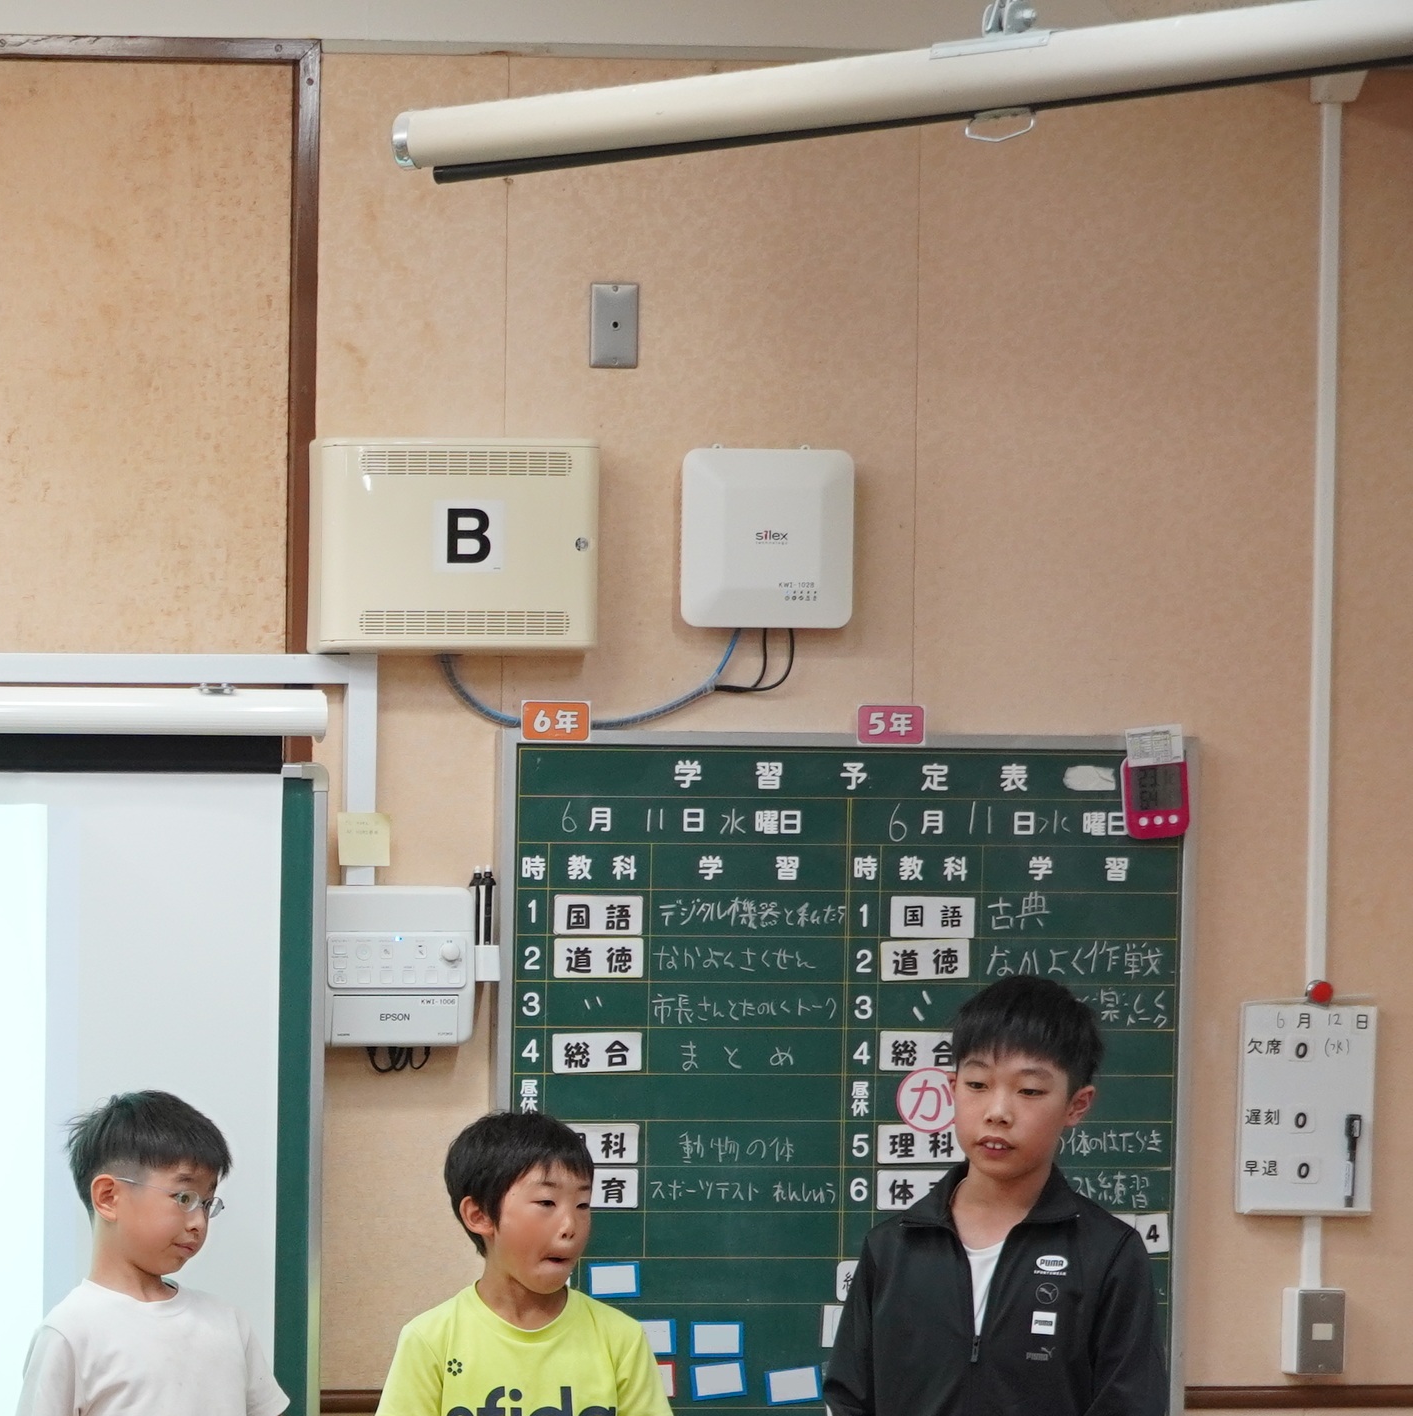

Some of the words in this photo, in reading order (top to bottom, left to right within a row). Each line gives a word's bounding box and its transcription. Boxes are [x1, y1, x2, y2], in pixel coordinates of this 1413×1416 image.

[446, 507, 491, 564] B
[755, 530, 788, 541] silex
[533, 709, 579, 734] 6年
[868, 712, 913, 736] 5年
[674, 759, 1028, 792] 学習予定表
[522, 855, 546, 880] 時
[567, 855, 637, 880] 教科
[698, 855, 800, 880] 学習
[853, 856, 878, 880] 時
[899, 856, 968, 881] 教科
[1028, 856, 1129, 882] 学習
[527, 899, 536, 923] 1
[566, 903, 631, 931] 国語
[858, 903, 868, 927] 1
[903, 905, 963, 928] 国語
[987, 891, 1051, 930] 古典
[524, 946, 540, 970] 2
[565, 946, 632, 974] 道徳
[856, 949, 872, 973] 2
[892, 948, 959, 976] 道徳
[522, 992, 541, 1016] 3
[854, 995, 872, 1020] 3
[379, 1013, 411, 1021] EPSON
[521, 1039, 540, 1063] 4
[564, 1040, 630, 1069] 総合
[681, 1040, 794, 1071] まとめ
[853, 1042, 871, 1065] 4
[891, 1040, 953, 1067] 総合
[1247, 1038, 1283, 1055] 欠席
[1294, 1042, 1308, 1059] 0
[520, 1079, 539, 1115] 昼休
[851, 1081, 869, 1117] 昼休
[908, 1079, 953, 1122] か
[1244, 1109, 1280, 1126] 遅刻
[1294, 1112, 1307, 1129] 0
[678, 1131, 795, 1164] 動物の体
[852, 1134, 870, 1158] 5
[889, 1131, 955, 1158] 理科
[1243, 1160, 1278, 1177] 早退
[1297, 1162, 1310, 1179] 0
[850, 1177, 868, 1202] 6
[1145, 1224, 1160, 1243] 4
[1040, 1258, 1064, 1267] PUMA
[1033, 1319, 1053, 1327] PUMA
